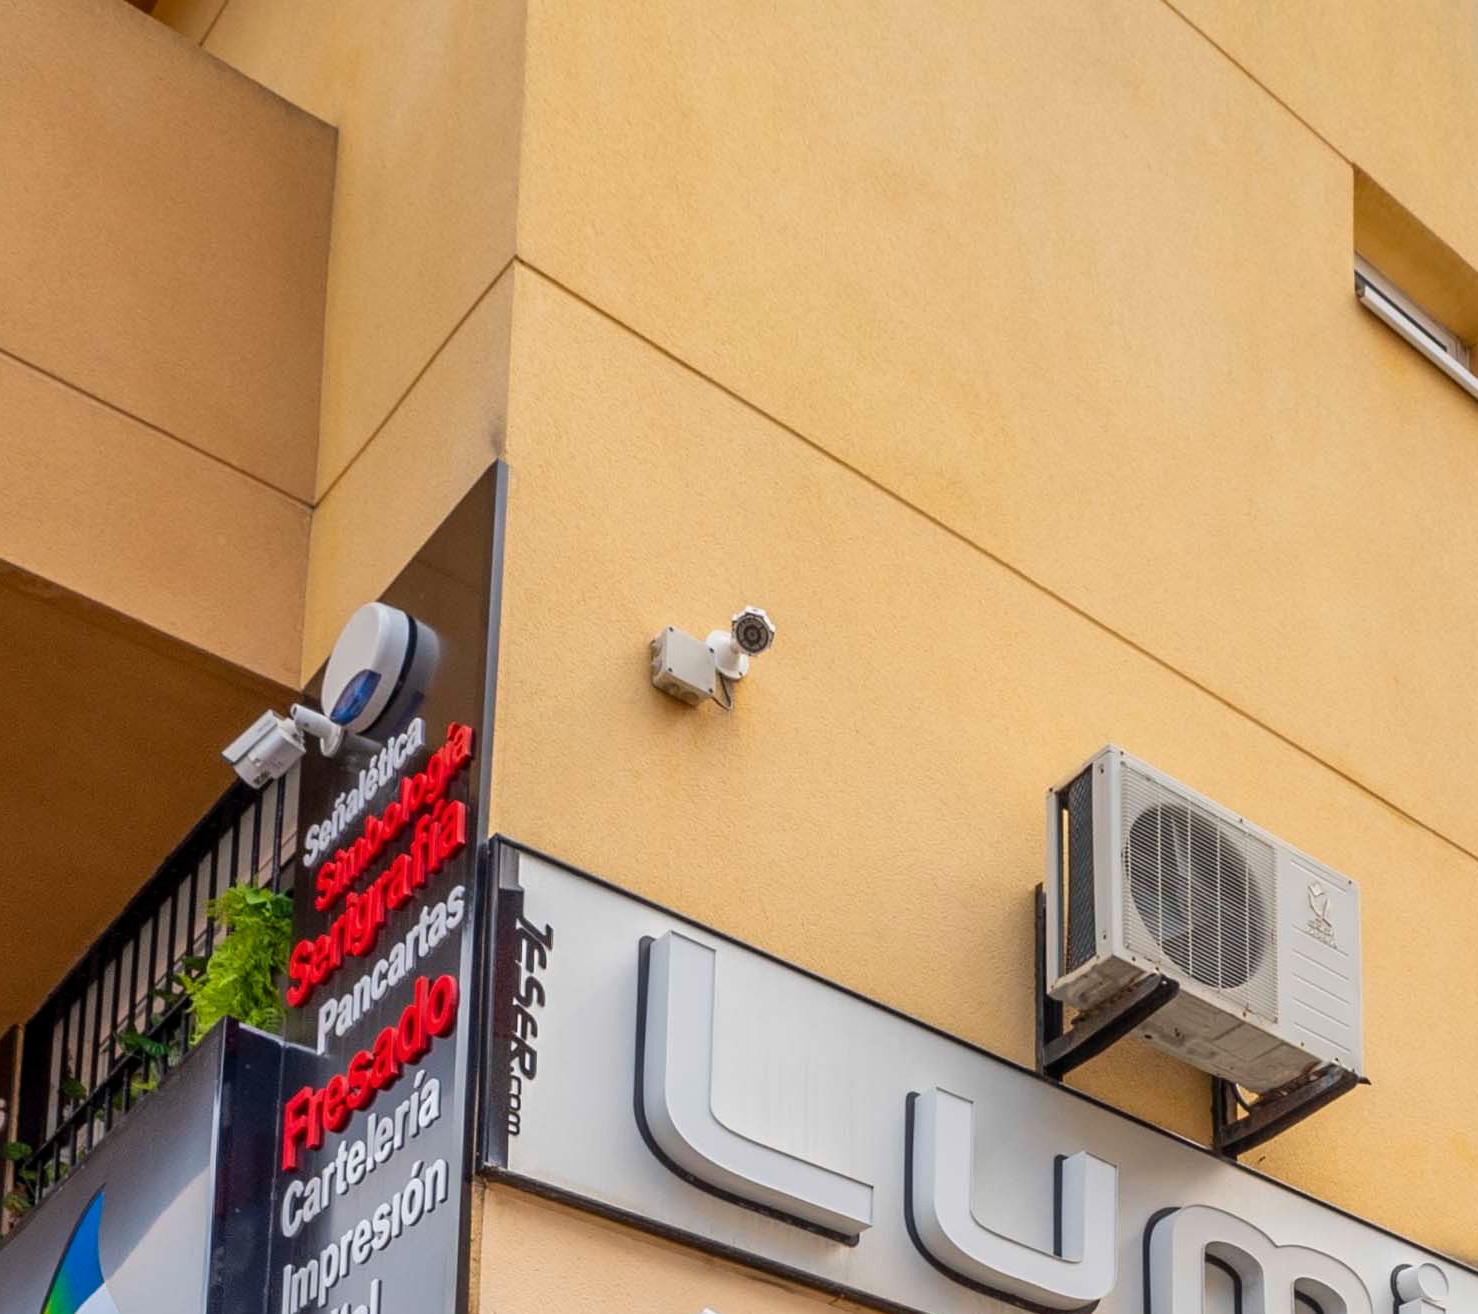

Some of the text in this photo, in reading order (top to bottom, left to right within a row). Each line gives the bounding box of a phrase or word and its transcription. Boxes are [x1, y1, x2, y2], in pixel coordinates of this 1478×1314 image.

[303, 717, 425, 867] Señalética
[315, 721, 472, 912] Simbología
[286, 799, 466, 1008] Serigrafía
[317, 885, 465, 1056] Pancartas
[282, 974, 459, 1173] Fresado
[282, 1069, 441, 1239] Cartelería
